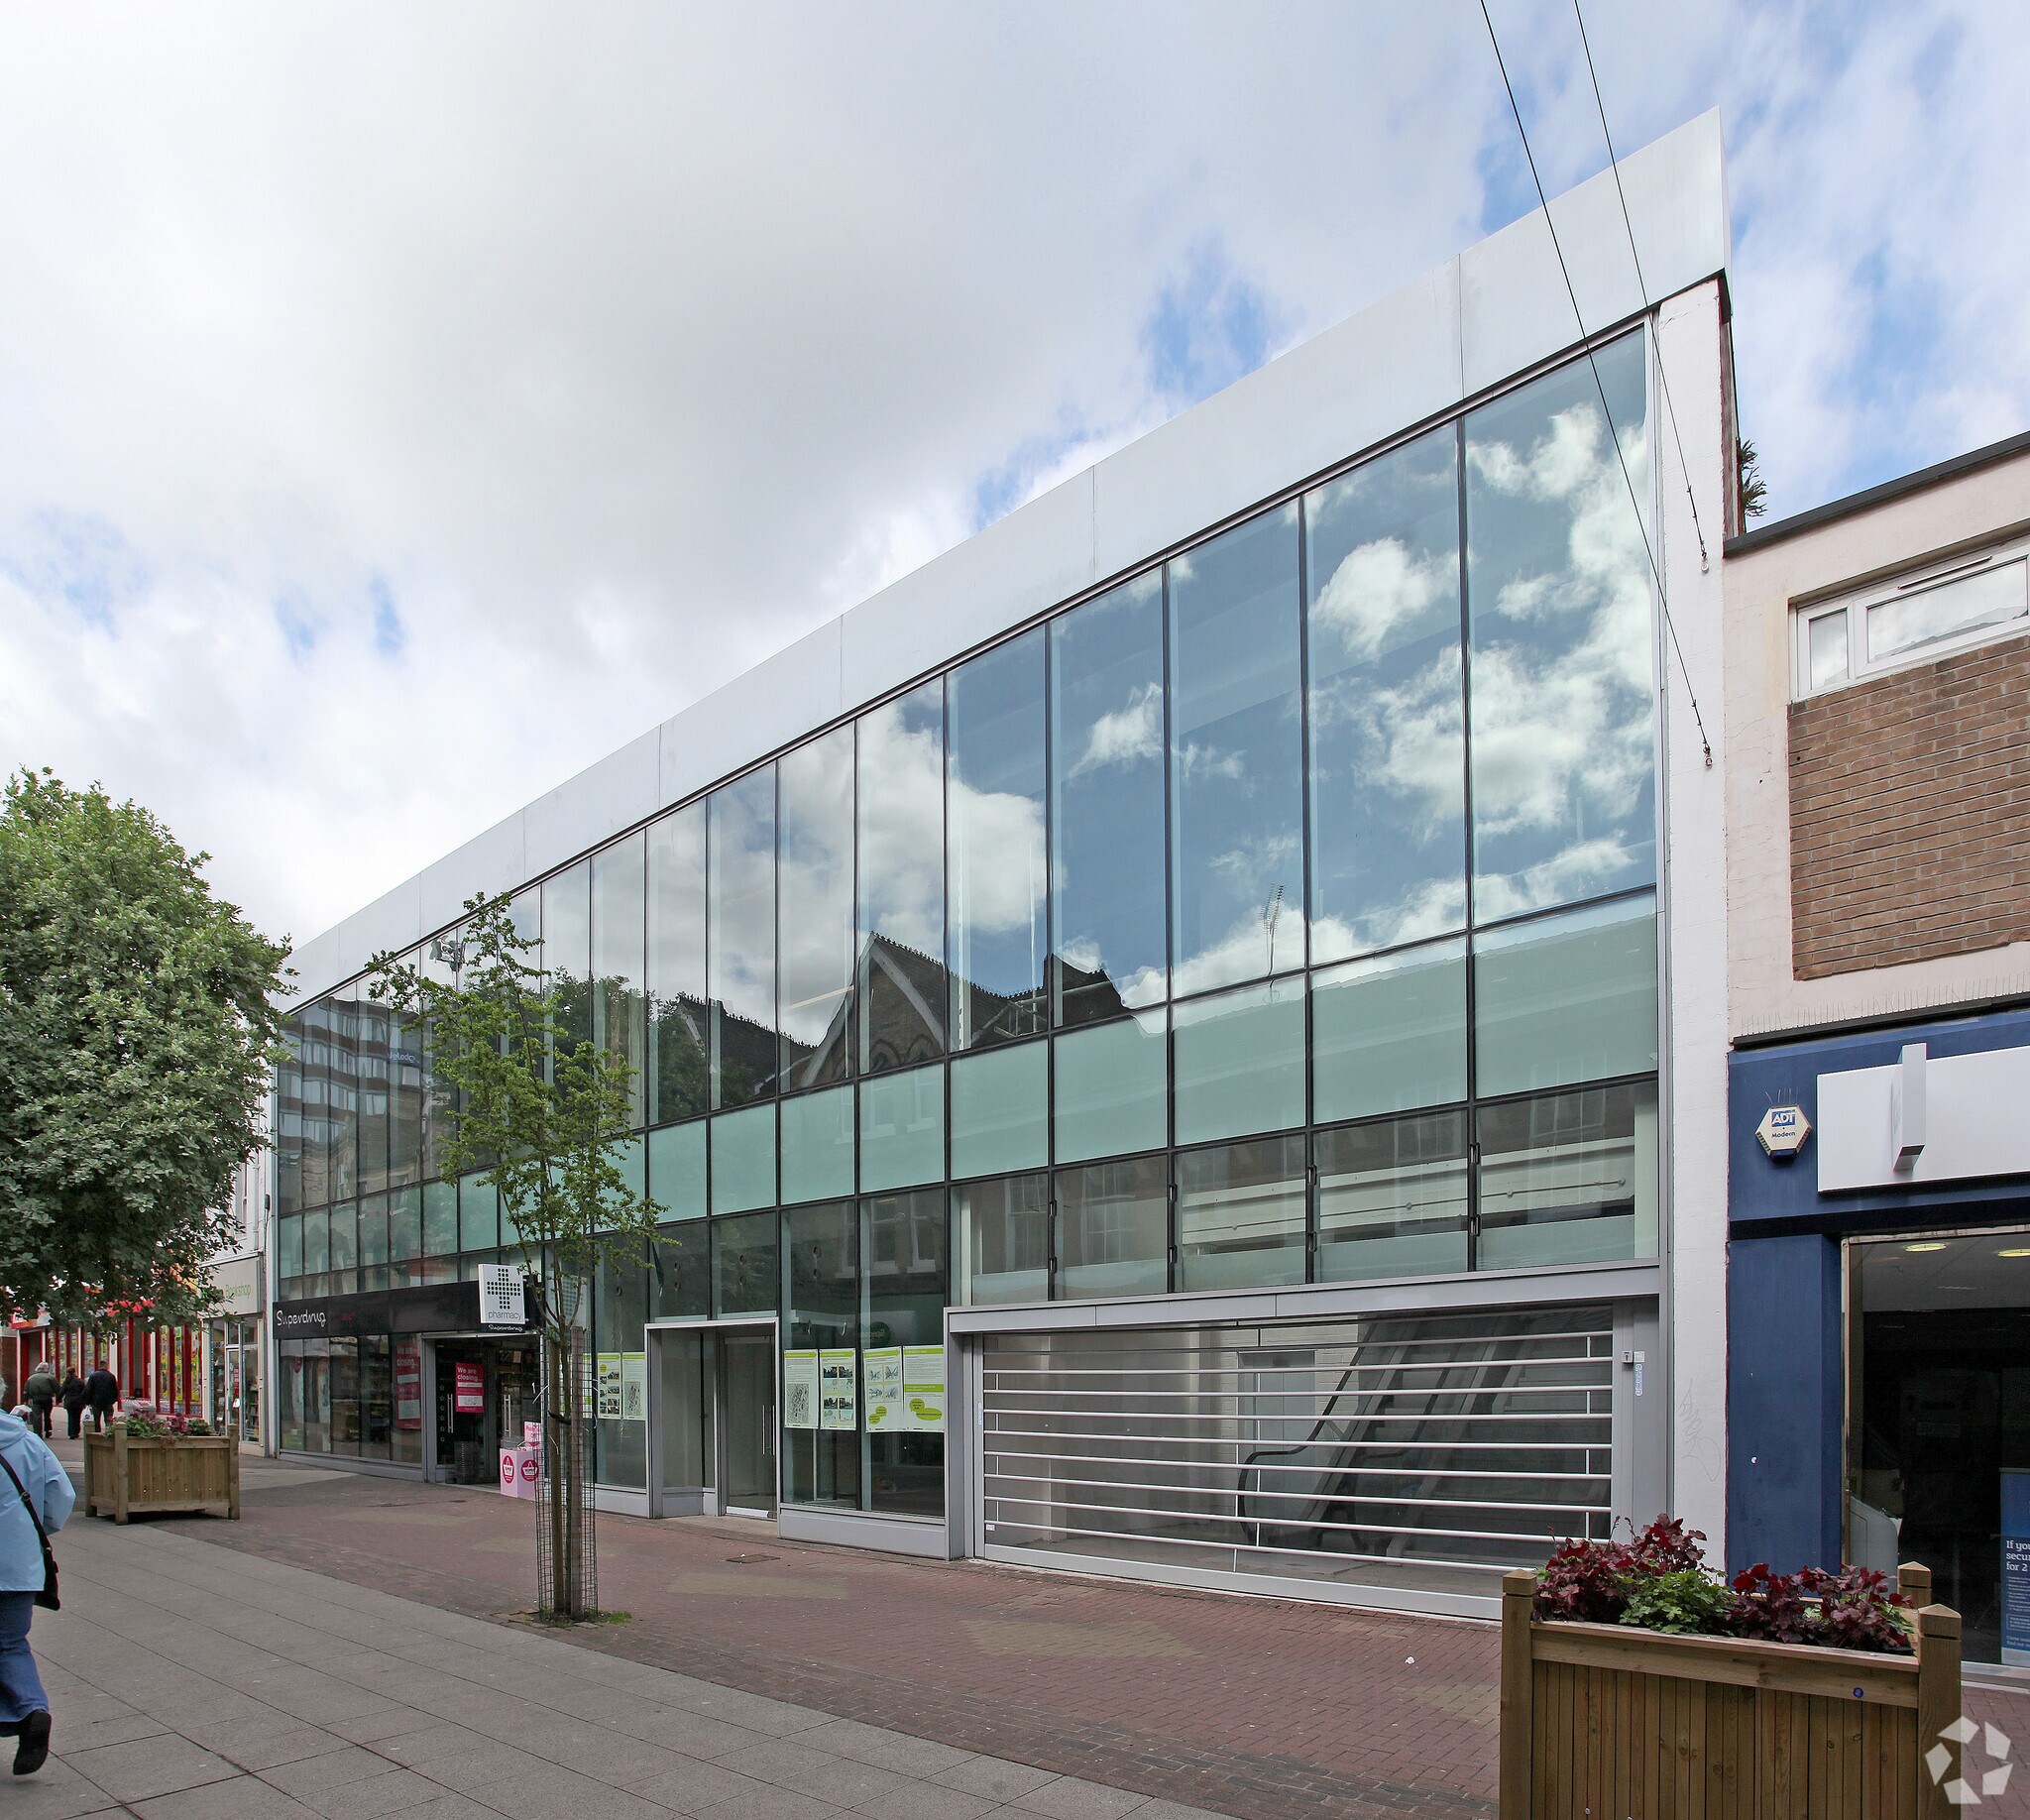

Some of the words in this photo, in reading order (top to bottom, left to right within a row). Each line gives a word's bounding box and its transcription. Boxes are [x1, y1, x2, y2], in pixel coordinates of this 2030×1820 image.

[1772, 1112, 1795, 1124] ADT
[277, 1309, 326, 1328] Superdrug
[488, 1310, 522, 1320] pharmacy
[2006, 1539, 2014, 1549] If
[2006, 1561, 2020, 1571] for
[2021, 1563, 2028, 1572] 2
